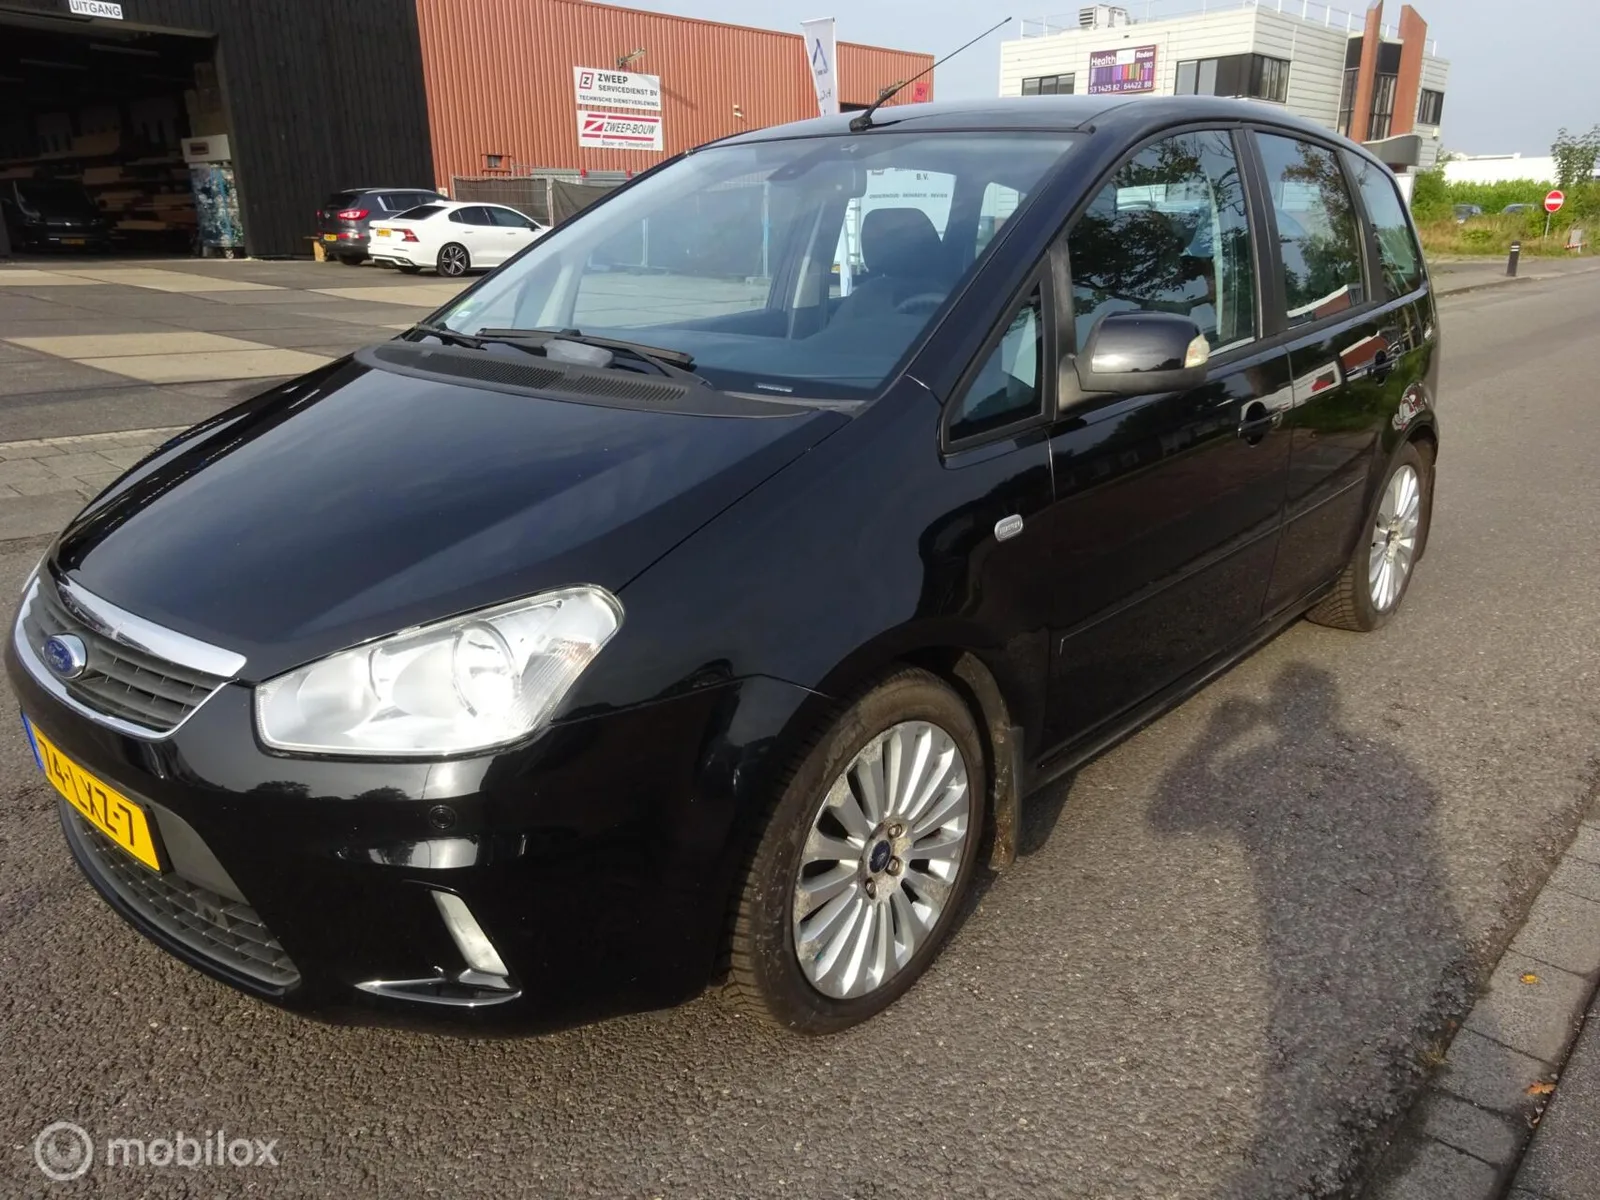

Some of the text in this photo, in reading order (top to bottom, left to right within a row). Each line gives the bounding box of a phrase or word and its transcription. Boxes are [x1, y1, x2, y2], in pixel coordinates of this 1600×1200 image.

[71, 0, 121, 16] UITGANG
[1091, 56, 1116, 66] Health
[597, 73, 628, 84] ZWEEP
[598, 85, 648, 95] SERVICEDIENST
[580, 94, 659, 107] TECHNISCHE DIENSTVERLENING
[604, 122, 656, 134] ZWEEP-BOUW
[38, 737, 134, 847] 74-LXZ-7
